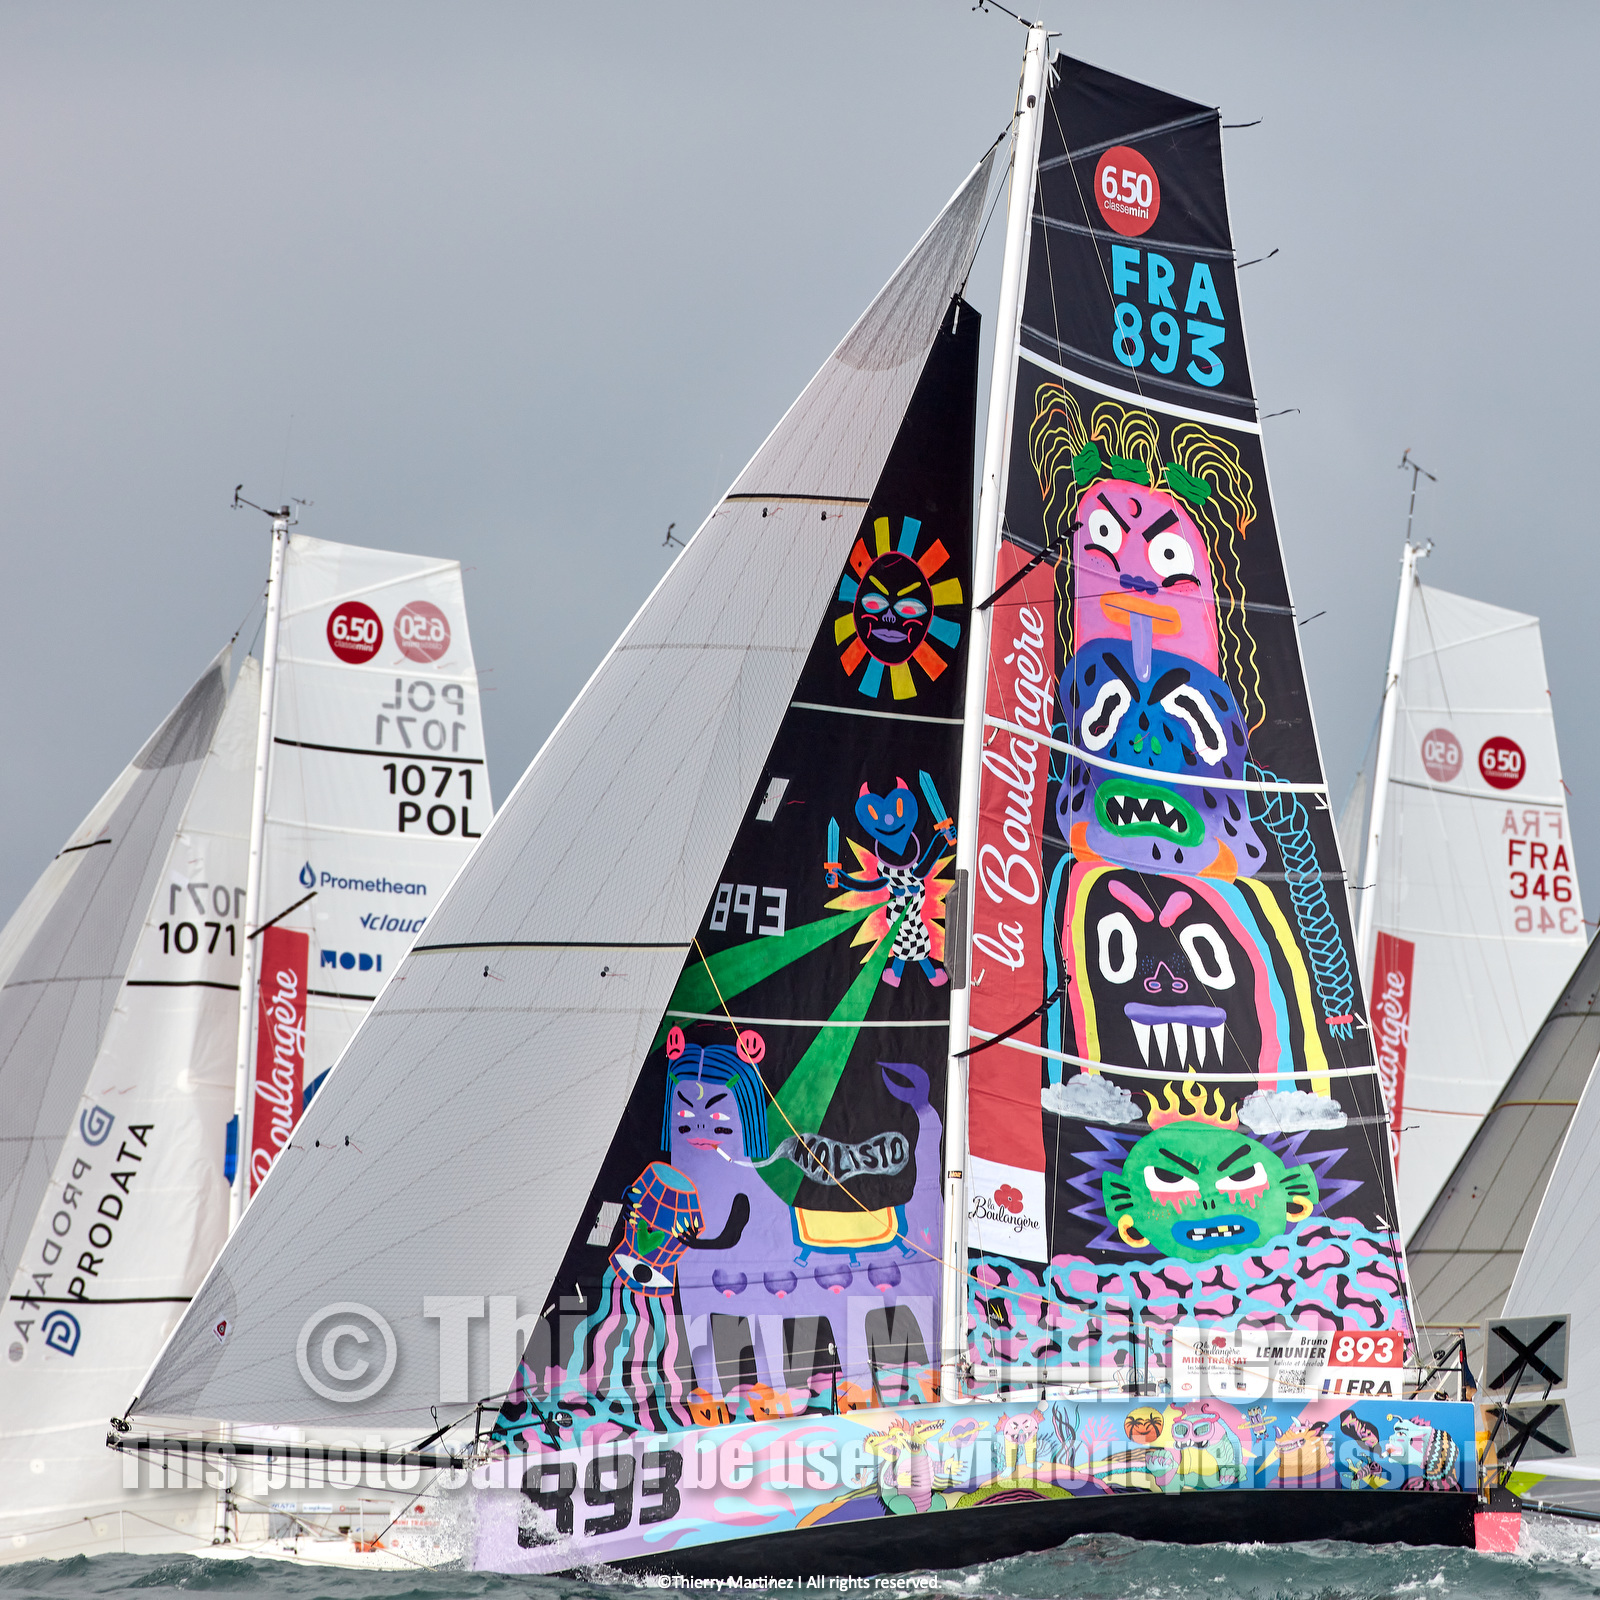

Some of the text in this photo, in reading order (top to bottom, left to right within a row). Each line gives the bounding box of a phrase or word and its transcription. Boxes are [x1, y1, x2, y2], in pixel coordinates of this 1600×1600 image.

[1101, 165, 1153, 208] 6.50
[1103, 198, 1149, 219] classemini
[1111, 244, 1225, 321] FRA
[1112, 302, 1226, 388] 893
[332, 614, 379, 644] 6.50
[383, 762, 473, 801] 1071
[972, 606, 1055, 973] la Boulangère
[398, 801, 482, 839] POL
[1508, 838, 1570, 872] FRA
[320, 871, 428, 896] Promethean
[1509, 871, 1573, 904] 346
[709, 882, 788, 937] 893
[158, 921, 236, 957] 1071
[320, 949, 383, 973] MODI
[66, 1124, 155, 1301] PRODATA
[967, 1195, 1041, 1234] Boulangère
[987, 1197, 996, 1211] la
[1255, 1346, 1327, 1359] LEMUNIER
[1300, 1336, 1329, 1346] Bruno
[1335, 1336, 1395, 1364] 893
[1182, 1356, 1248, 1365] MINI TRANSAT
[1346, 1379, 1393, 1398] FRA
